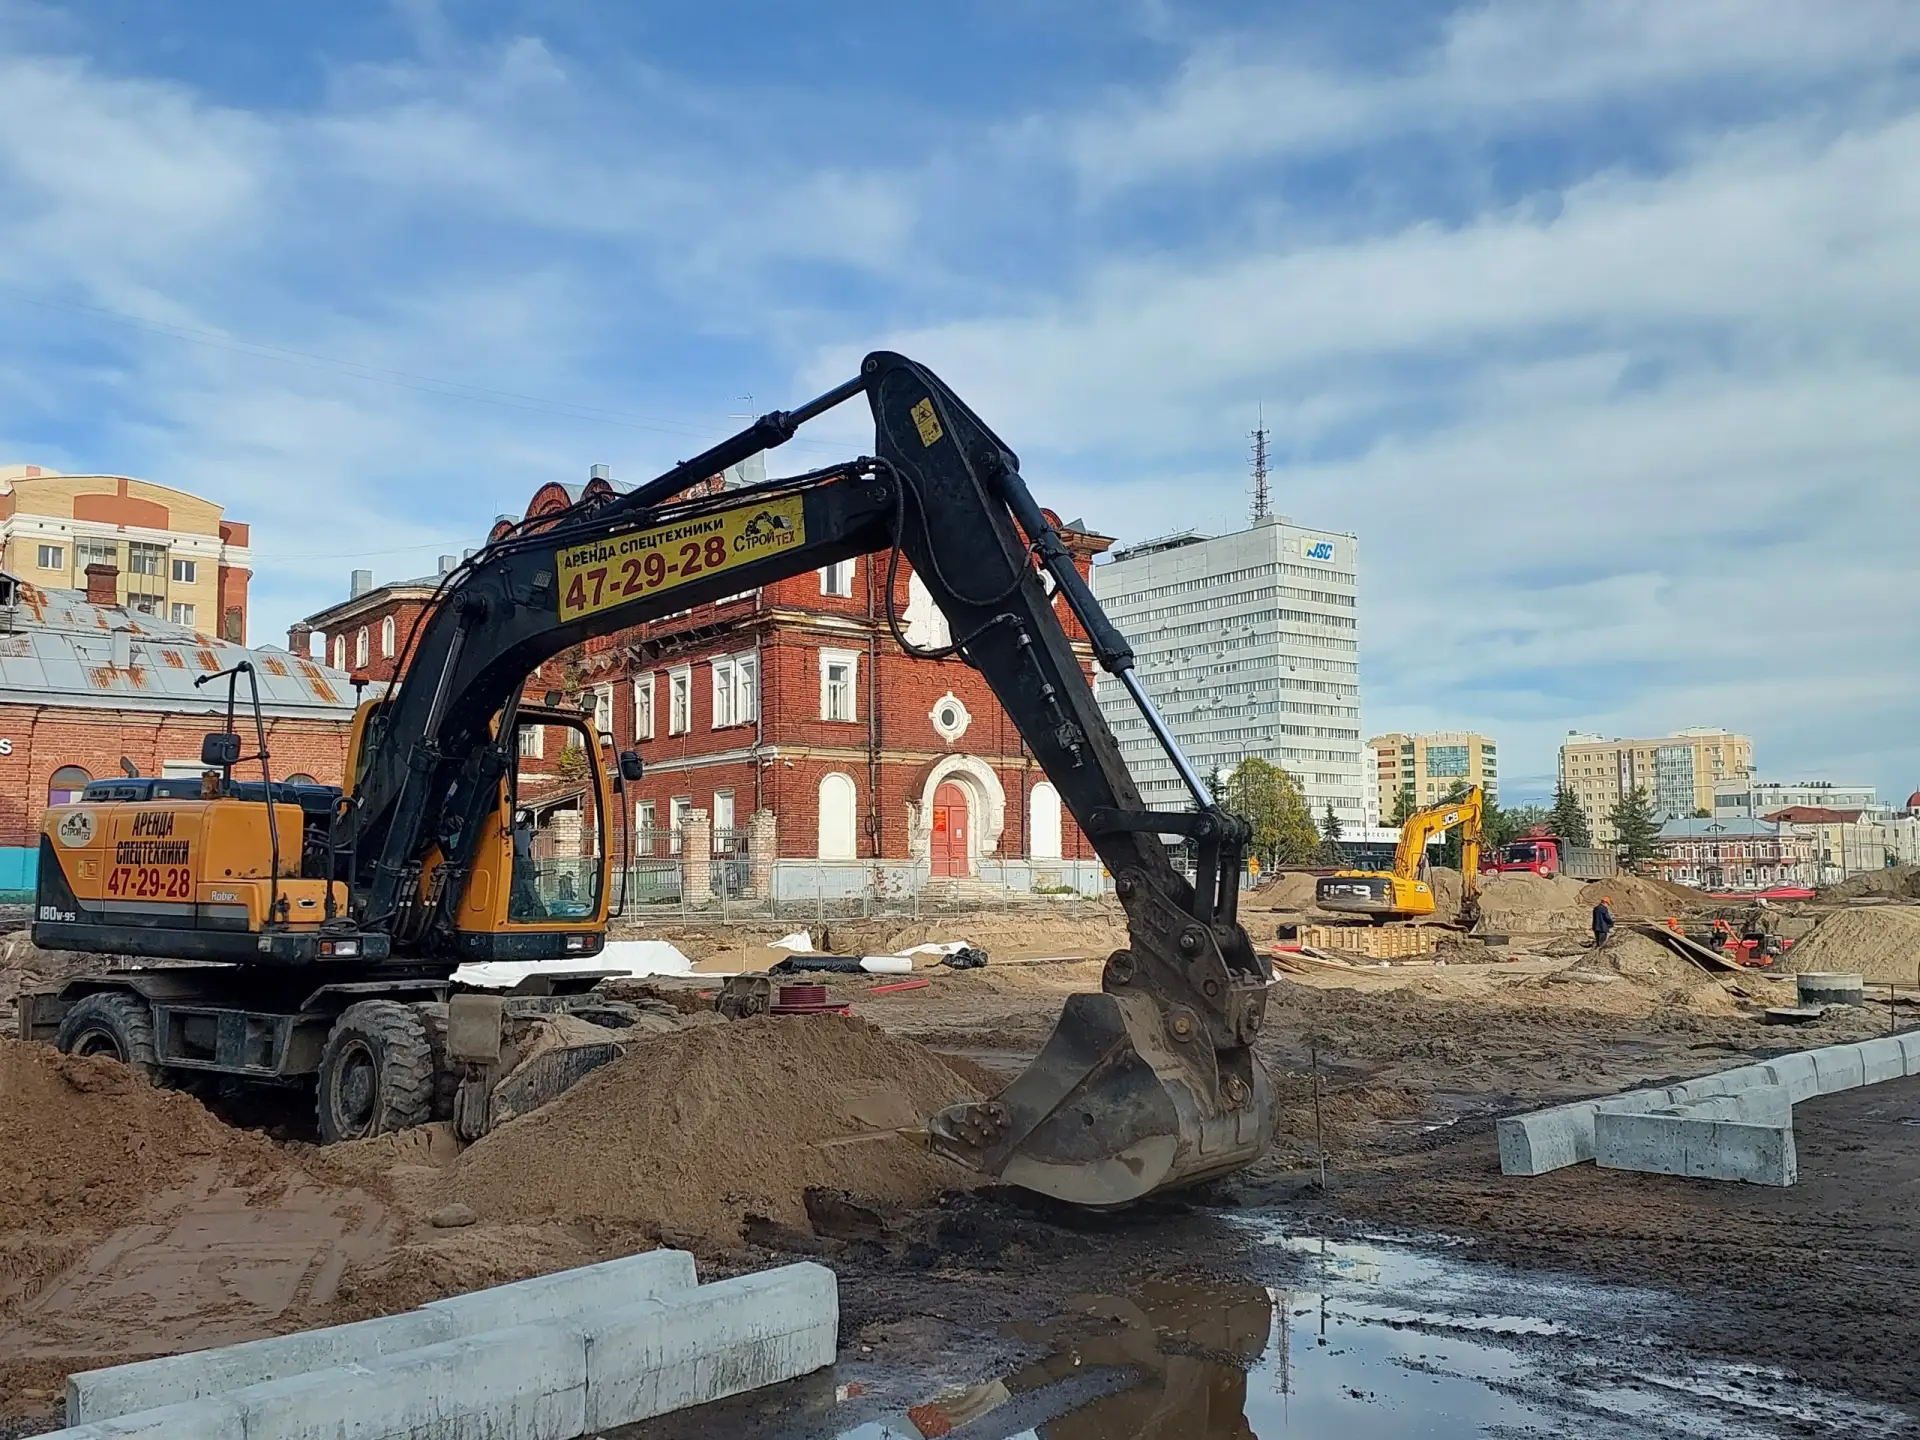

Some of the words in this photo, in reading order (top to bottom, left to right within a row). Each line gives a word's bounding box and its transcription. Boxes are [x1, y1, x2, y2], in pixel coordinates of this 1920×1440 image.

[564, 546, 616, 569] АРЕНДА
[620, 518, 724, 555] СПЕЦТЕХНИКИ
[565, 535, 727, 612] 47-29-28
[132, 811, 176, 838] АРЕНДА
[1442, 811, 1459, 826] JCB
[116, 840, 190, 868] СПЕЦТЕХНИКИ
[108, 867, 191, 898] 47-29-28
[211, 890, 239, 901] Robex
